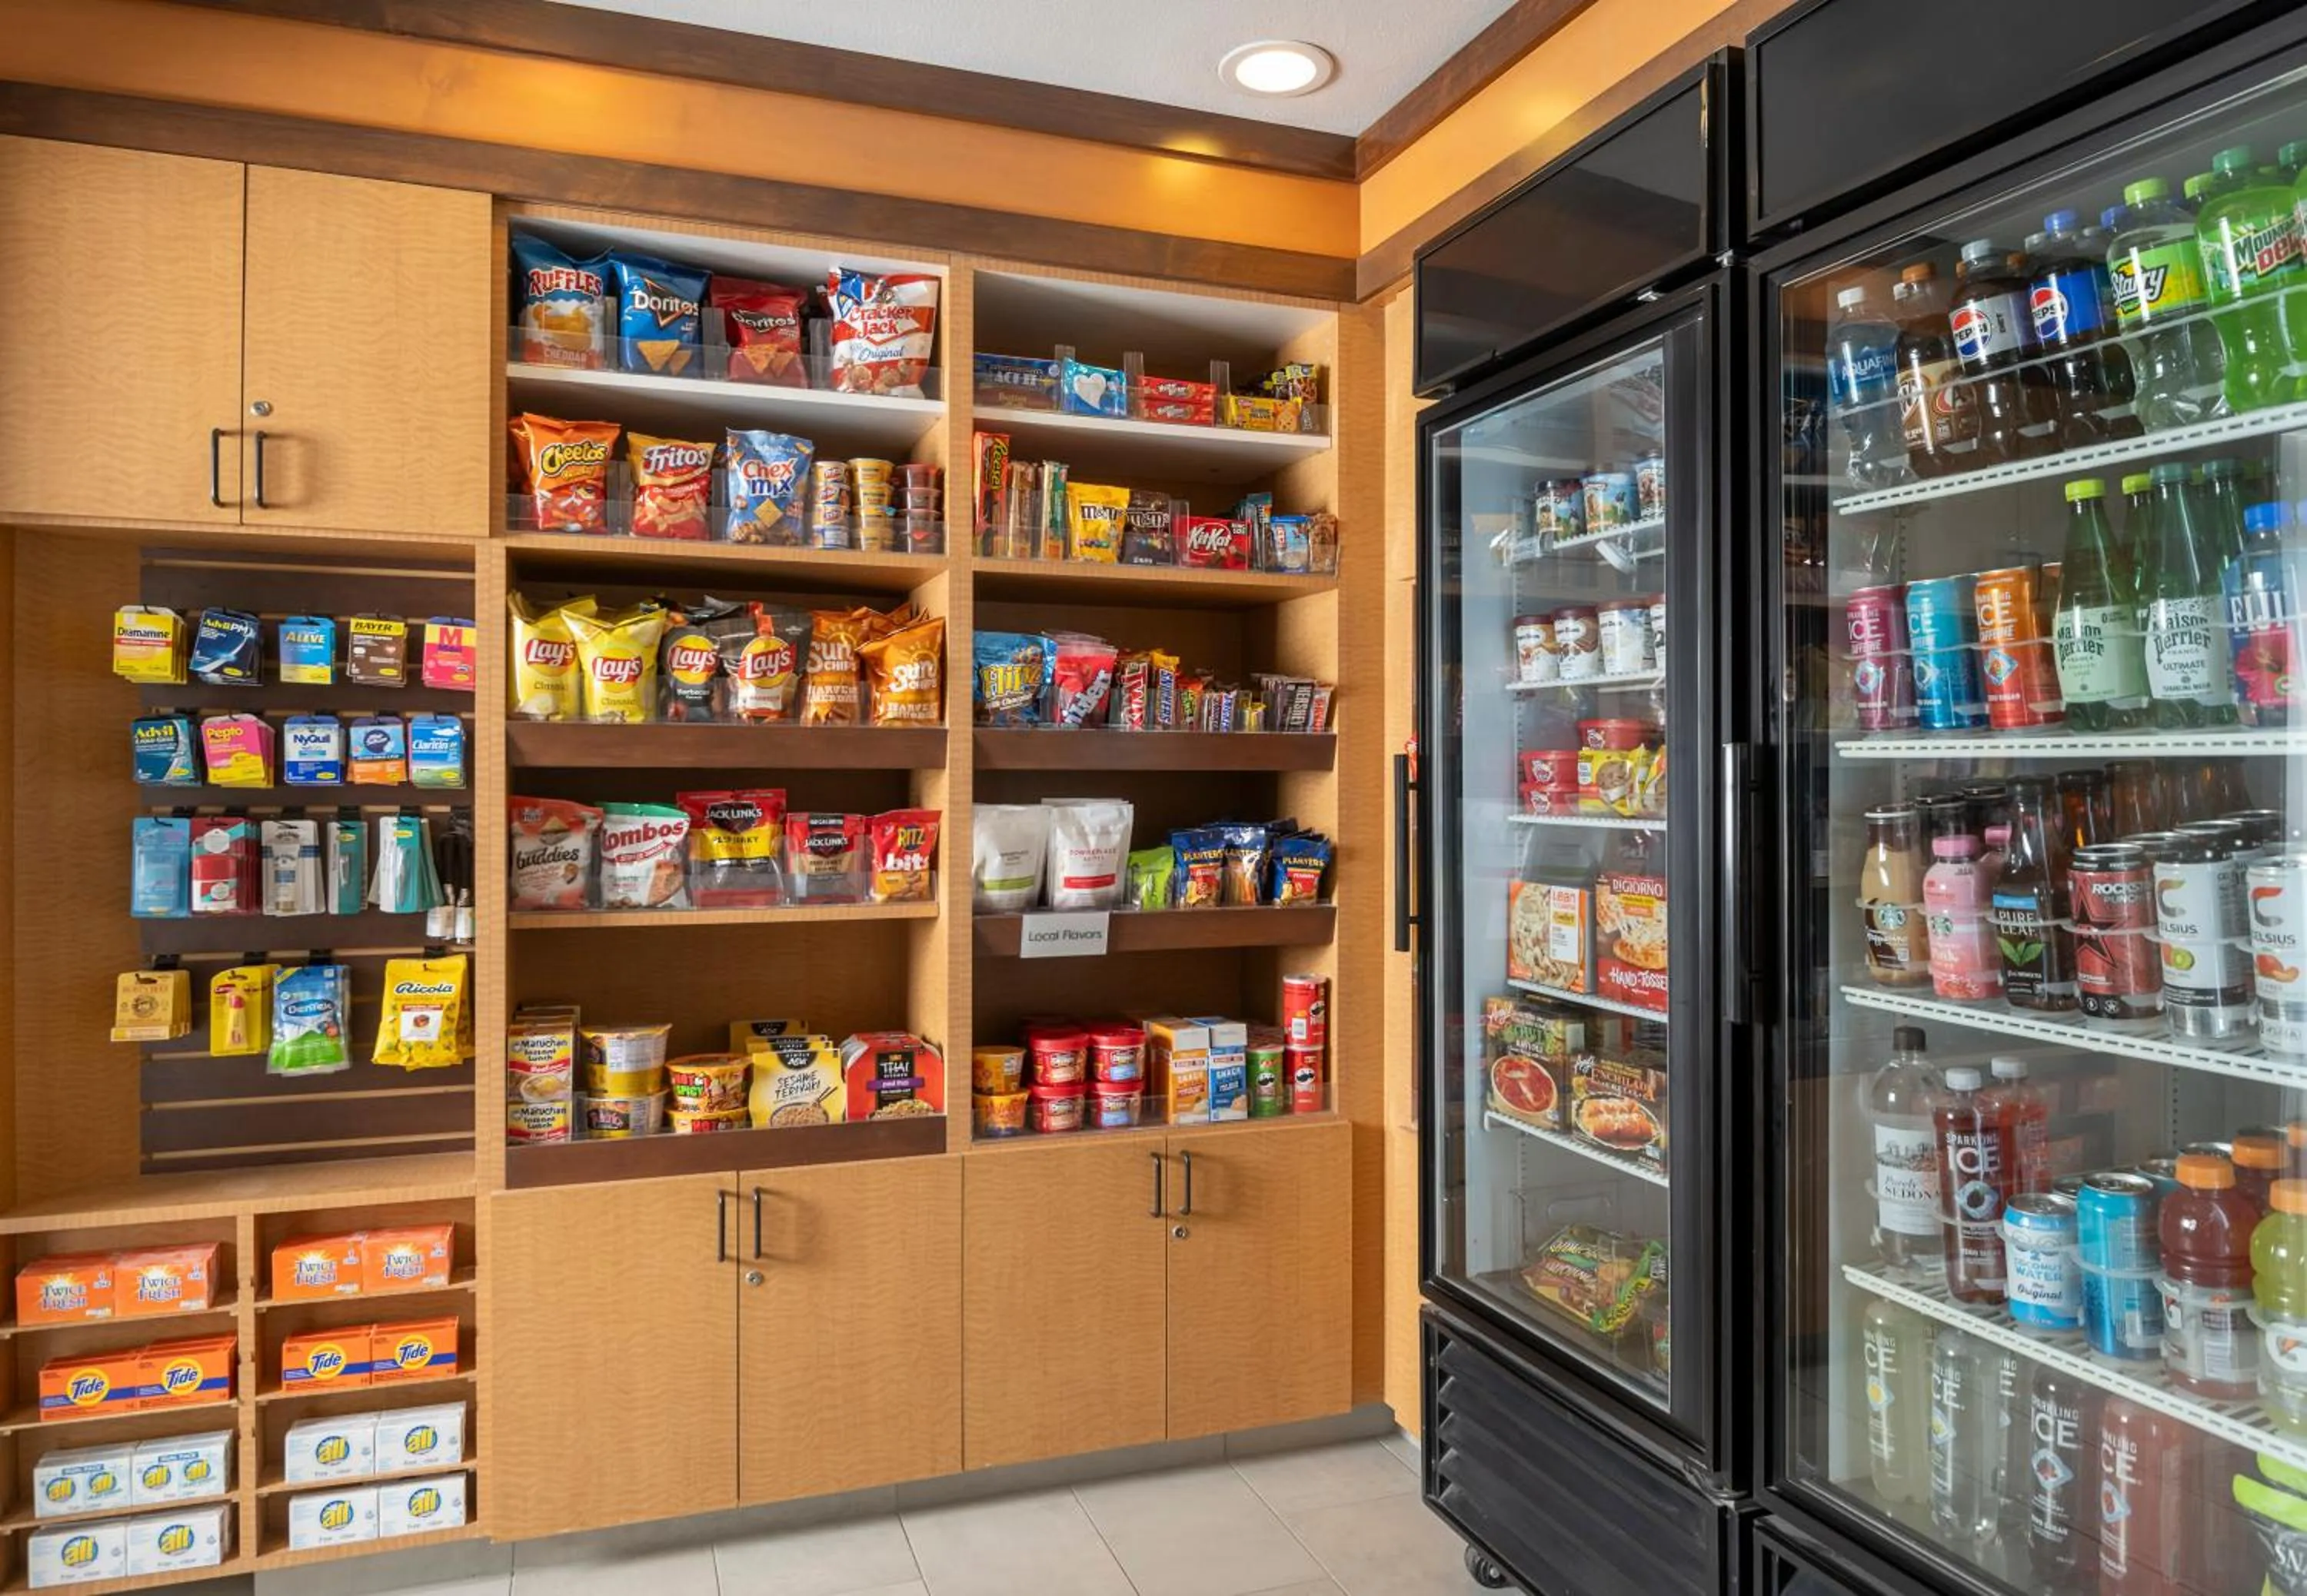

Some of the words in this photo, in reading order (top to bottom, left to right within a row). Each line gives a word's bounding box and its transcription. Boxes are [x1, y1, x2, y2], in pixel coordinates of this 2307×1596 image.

[529, 265, 604, 297] RUFFLES
[633, 291, 699, 317] Doritos
[850, 305, 913, 321] Cracker
[731, 310, 796, 331] Doritos
[857, 320, 899, 338] Jack
[857, 347, 905, 361] Original
[542, 441, 607, 474] Cheetos
[644, 446, 708, 472] Fritos
[743, 458, 797, 478] Chex
[1908, 611, 1940, 635] CE
[1976, 601, 2017, 627] ICE
[2154, 613, 2209, 631] aison
[117, 627, 171, 639] Dramamine
[285, 631, 326, 644] ALEVE
[355, 622, 393, 632] BAYER
[1848, 618, 1885, 640] ICE
[526, 639, 575, 667] Lay's
[671, 647, 717, 673] Lay's
[807, 640, 855, 673] Sun
[594, 657, 642, 683] Lay's
[746, 648, 791, 680] Lay's
[2162, 659, 2206, 672] ULTIMATE
[889, 660, 937, 693] Sun
[136, 725, 174, 739] Advil
[294, 734, 331, 746] NyQuil
[412, 739, 448, 750] Claritin
[706, 810, 730, 820] JACK
[804, 836, 825, 847] JACK
[900, 830, 926, 846] RITZ
[516, 847, 580, 870] buddies
[1182, 849, 1224, 862] PLANTERS
[1282, 857, 1326, 867] PLANTERS
[1612, 878, 1663, 897] DIGIORNO
[1999, 909, 2035, 923] PURE
[1028, 929, 1059, 942] Local
[1062, 929, 1102, 941] Flavors
[394, 983, 454, 995] Ricola
[1608, 966, 1669, 991] HAND-TOSSE
[288, 1002, 333, 1014] DenTek
[521, 1039, 568, 1049] Maruchan
[881, 1061, 909, 1073] THAI
[777, 1069, 818, 1089] SESAME
[774, 1081, 821, 1099] TERIYAKI
[521, 1107, 567, 1116] Maruchan
[2016, 1266, 2064, 1283] WATER
[2017, 1283, 2062, 1300] Original
[311, 1354, 342, 1373] Tide
[398, 1344, 429, 1365] Tide
[1865, 1341, 1898, 1374] CE
[166, 1367, 198, 1388] Tide
[71, 1378, 105, 1400] Tide
[1932, 1374, 1966, 1410] CE
[317, 1437, 347, 1465] all
[405, 1427, 436, 1455] all
[186, 1458, 208, 1481] all
[2101, 1442, 2139, 1485] CE
[91, 1471, 115, 1495] all
[144, 1465, 169, 1489] all
[47, 1477, 72, 1501] all
[410, 1488, 440, 1518] all
[321, 1500, 351, 1530] all
[159, 1525, 191, 1555] all
[62, 1537, 95, 1566] all
